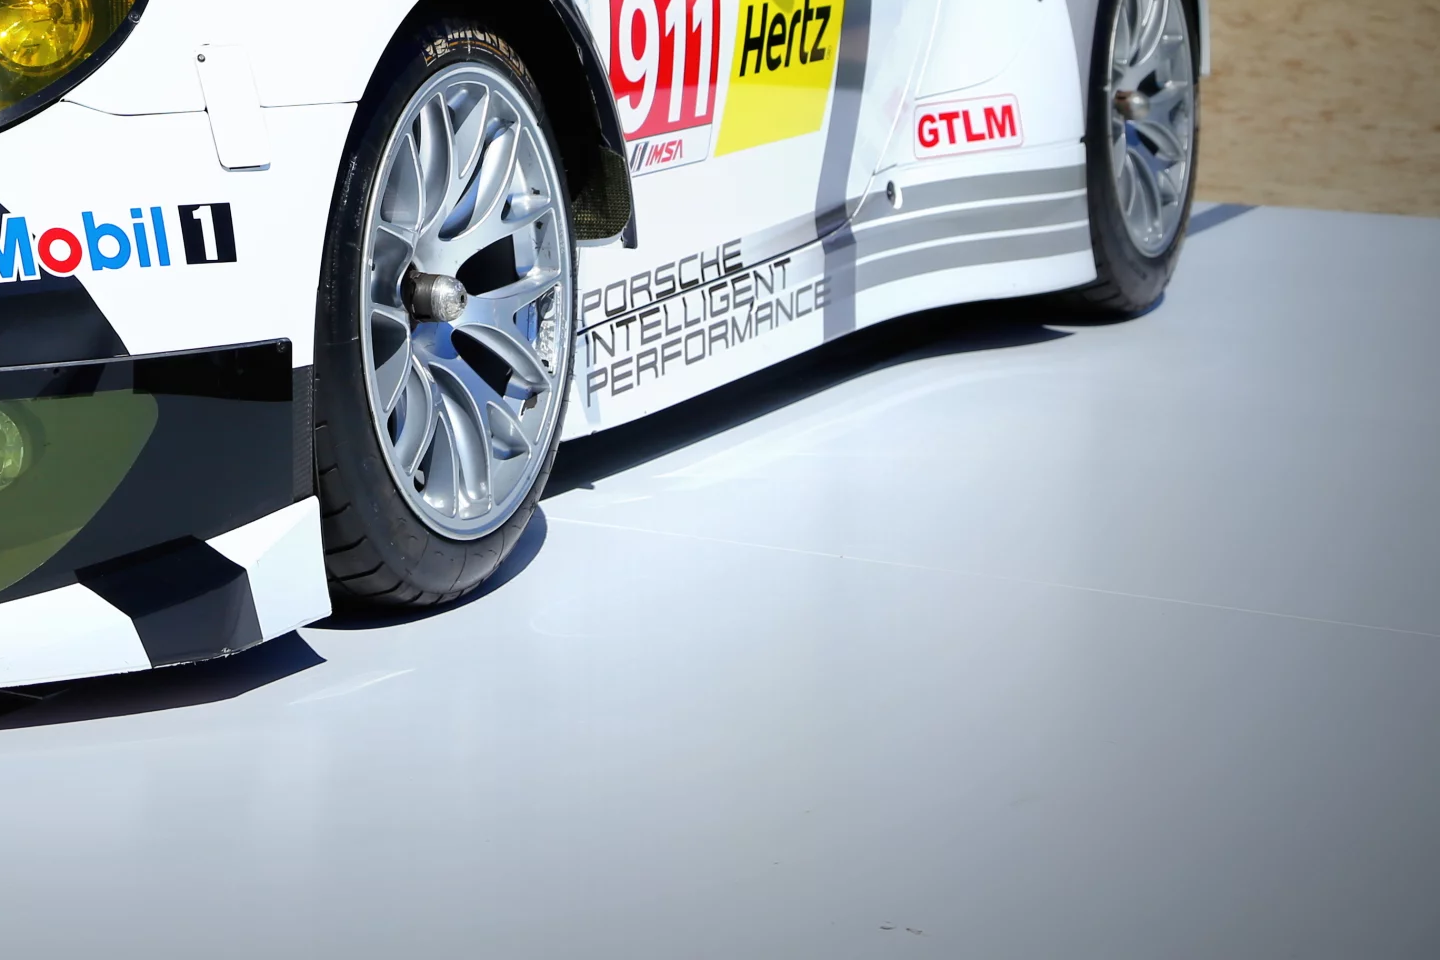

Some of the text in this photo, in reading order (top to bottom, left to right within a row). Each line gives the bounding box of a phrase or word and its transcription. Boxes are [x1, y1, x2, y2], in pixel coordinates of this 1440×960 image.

[645, 139, 683, 167] IMSA
[917, 104, 1017, 148] GTLM
[188, 204, 222, 262] 1
[582, 238, 744, 327] PORSCHE
[586, 257, 791, 368] INTELLIGENT
[587, 276, 832, 408] PERFORMANCE
